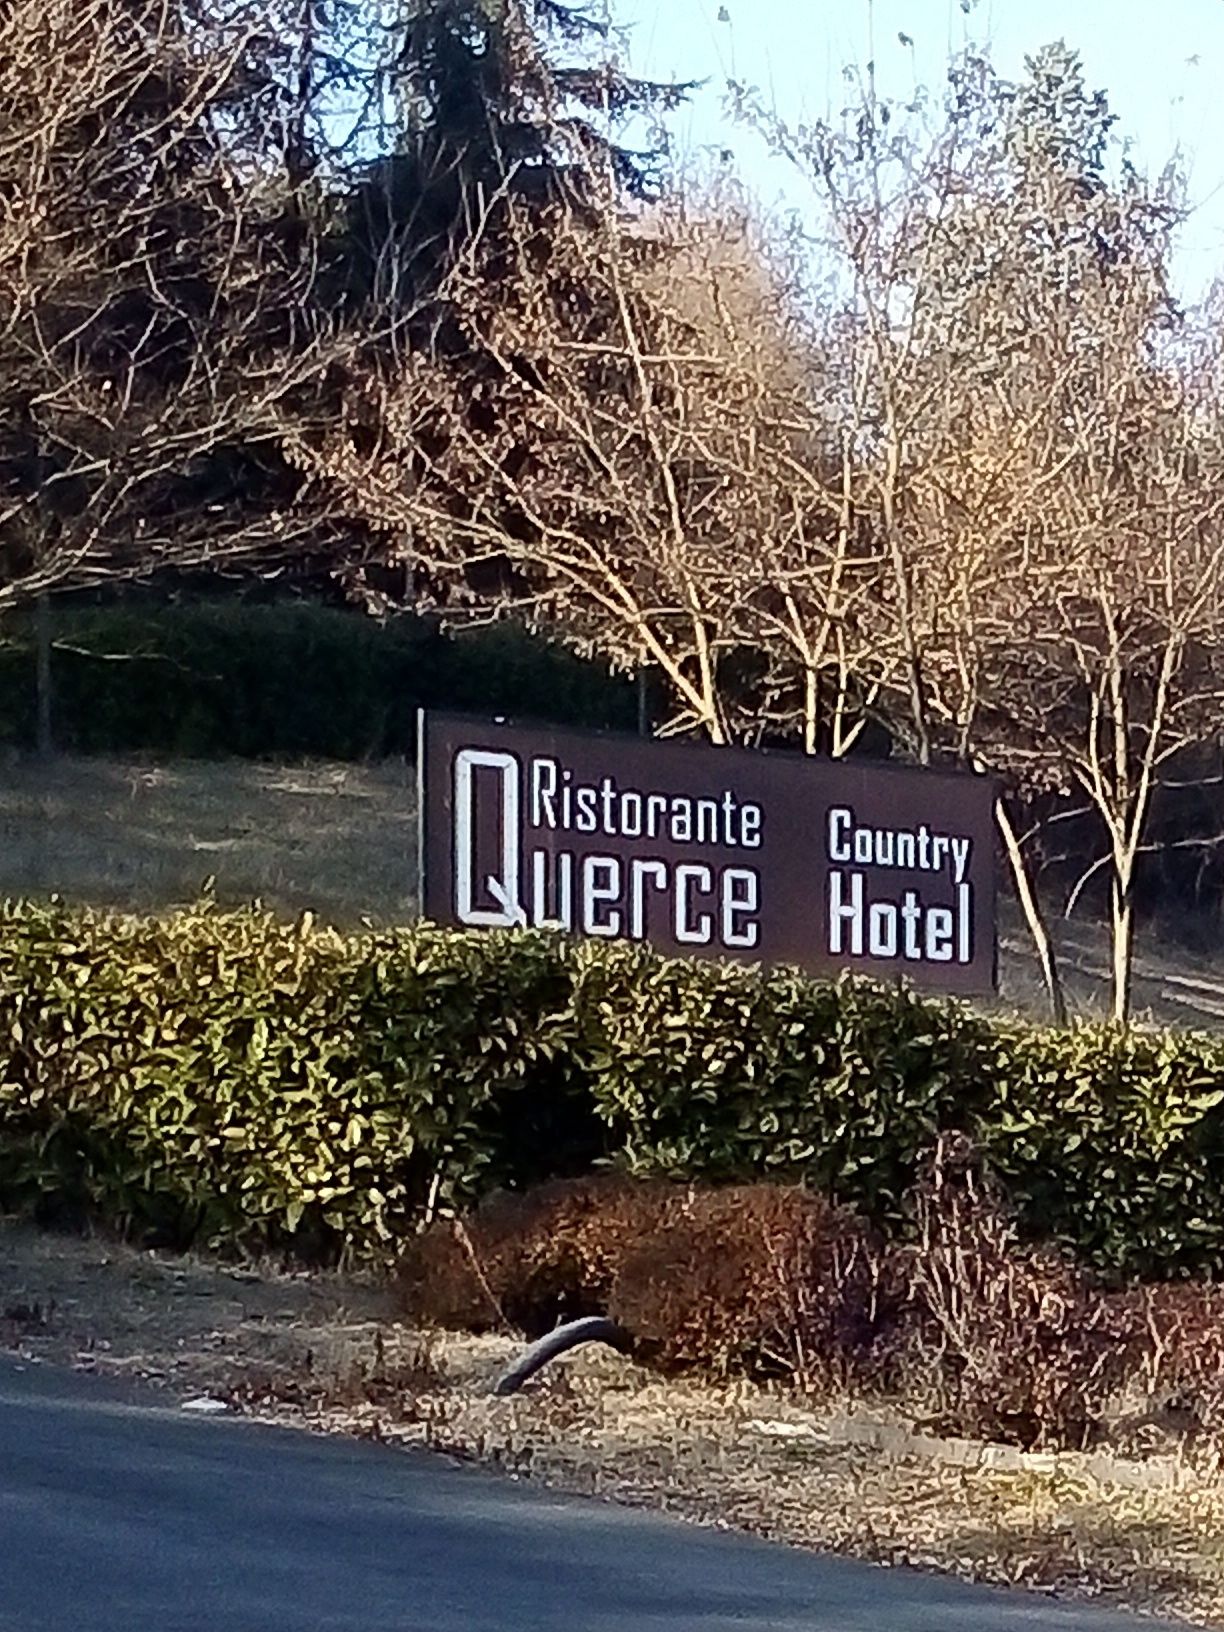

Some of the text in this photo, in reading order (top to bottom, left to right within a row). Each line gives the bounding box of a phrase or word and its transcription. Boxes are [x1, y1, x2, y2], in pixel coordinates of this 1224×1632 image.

[455, 749, 759, 948] Querce
[531, 758, 761, 848] Ristorante
[828, 808, 970, 884] Country
[828, 870, 971, 964] Hotel
